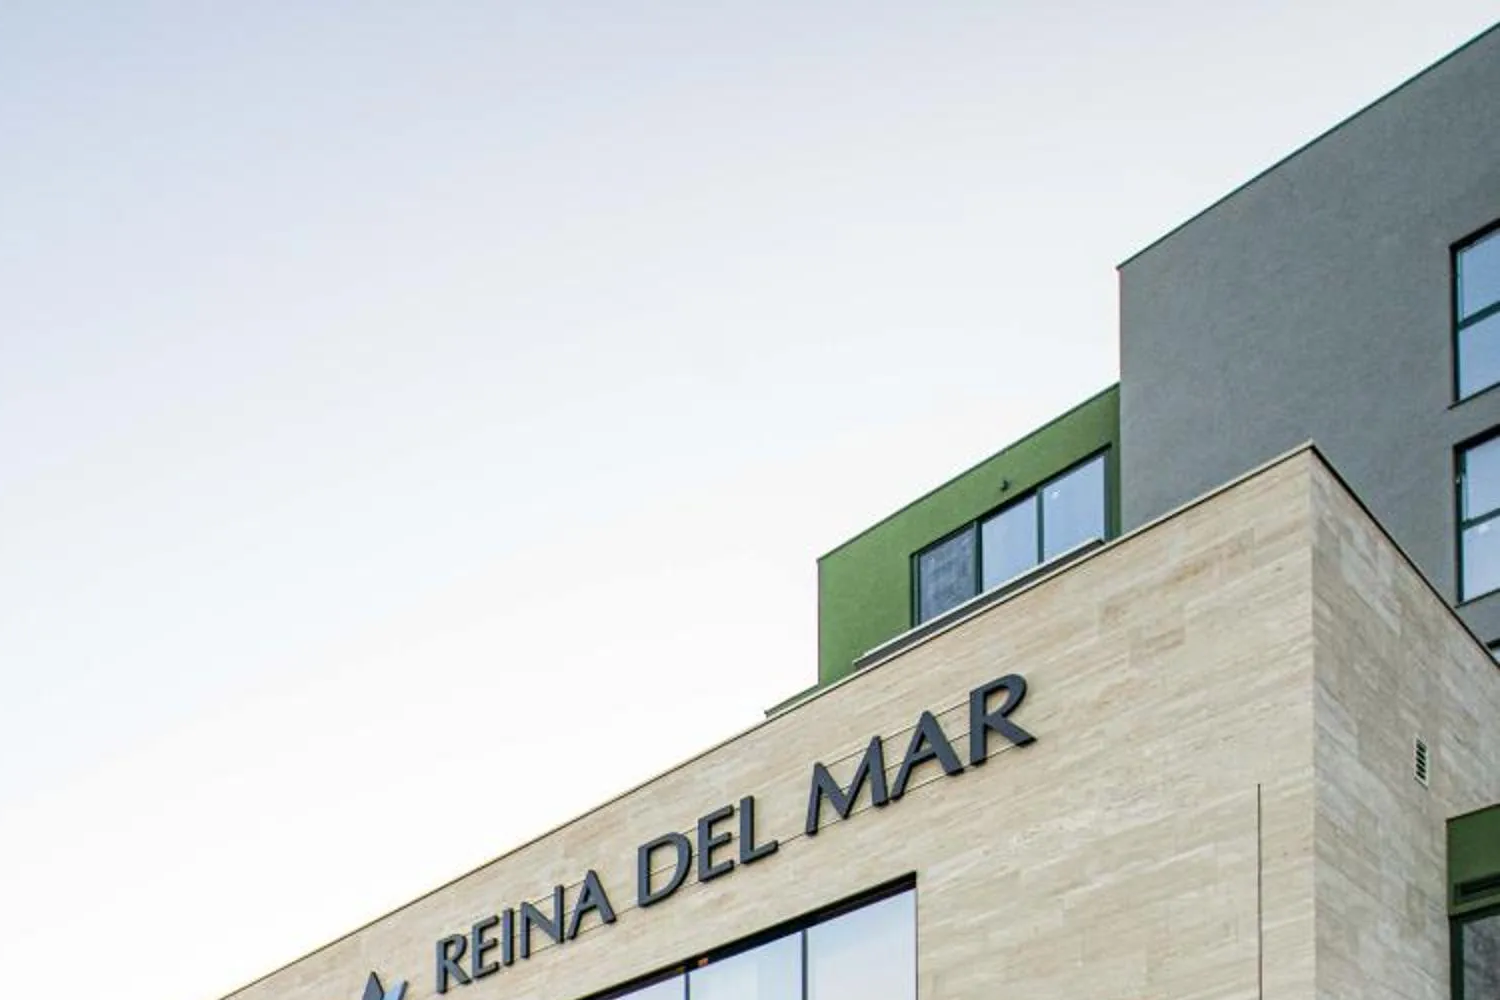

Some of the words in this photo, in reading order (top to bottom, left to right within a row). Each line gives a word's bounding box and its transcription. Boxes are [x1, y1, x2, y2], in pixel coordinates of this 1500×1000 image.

[436, 870, 616, 994] REINA
[637, 796, 778, 908] DEL
[806, 673, 1037, 836] MAR
